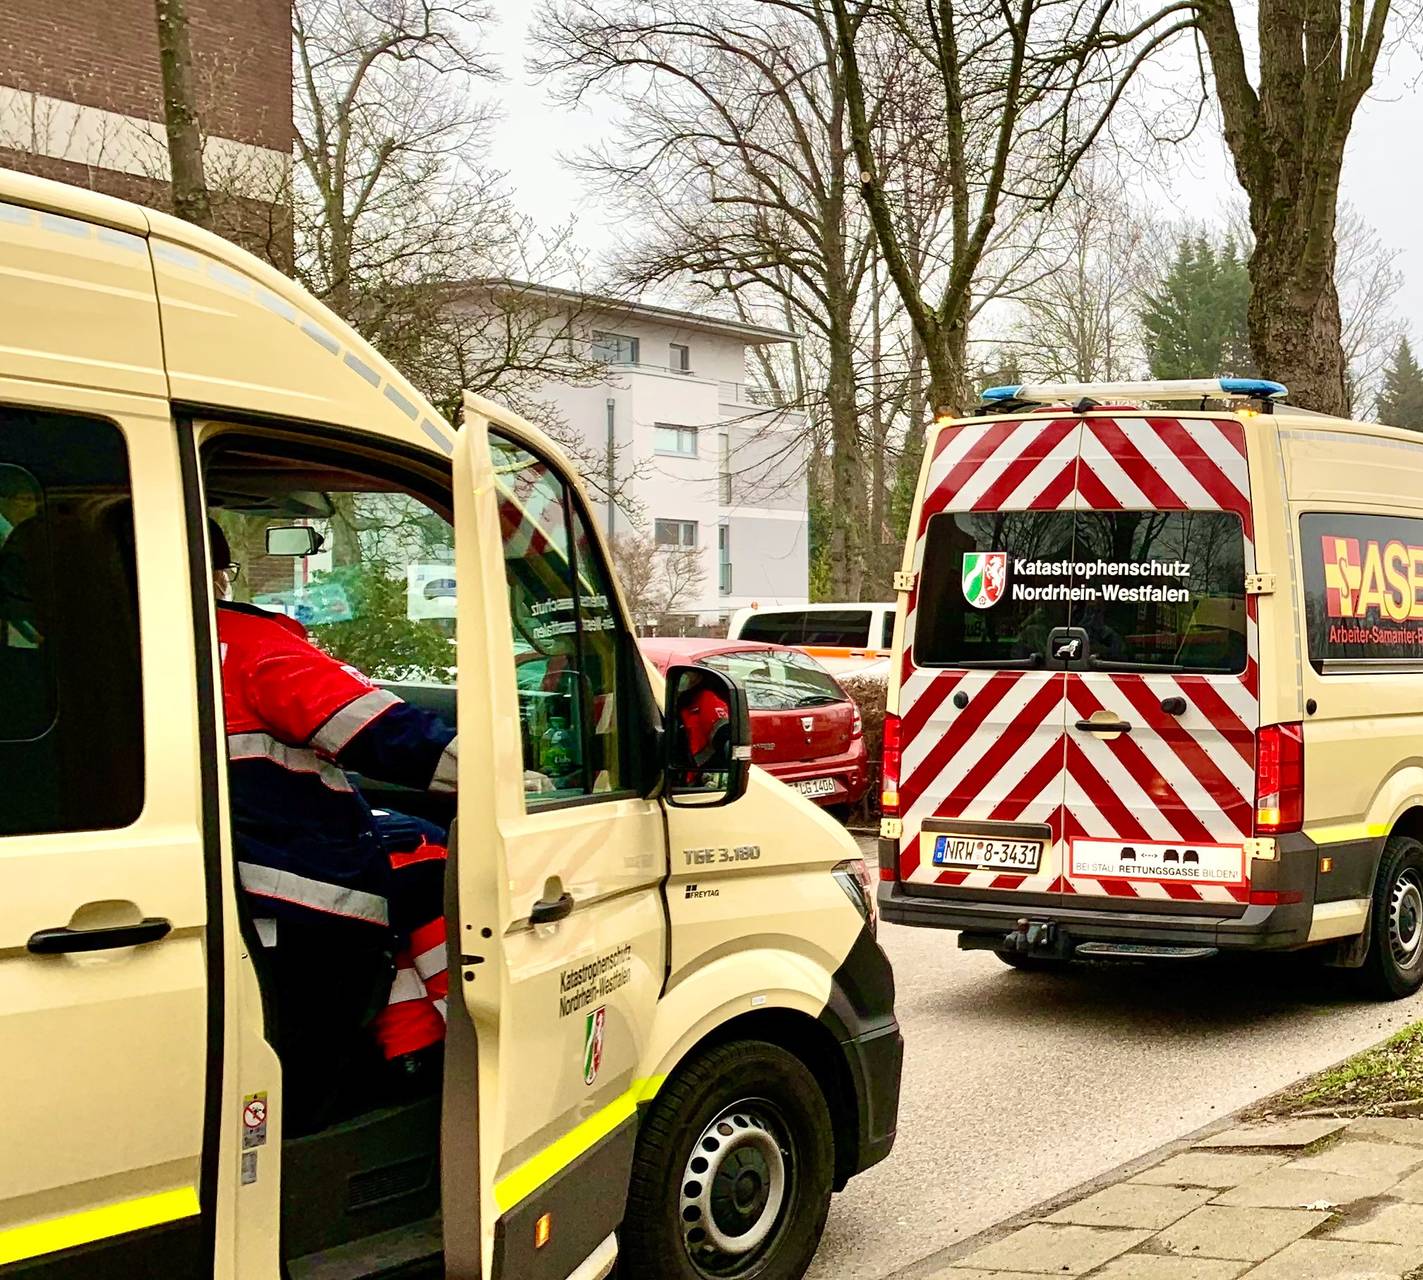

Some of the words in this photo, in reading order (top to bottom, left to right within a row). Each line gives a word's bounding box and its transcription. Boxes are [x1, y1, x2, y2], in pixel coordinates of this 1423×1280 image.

[1013, 558, 1191, 580] Katastrophenschutz
[1012, 583, 1190, 603] Nordrhein-Westfalen
[945, 840, 976, 861] NRW
[983, 842, 1038, 866] 8-3431
[1118, 864, 1200, 878] RETTUNGSGASSE
[690, 889, 720, 899] FREYTAG
[560, 943, 631, 994] Katastrophenschutz
[559, 966, 631, 1018] Nordrhein-Westfalen
